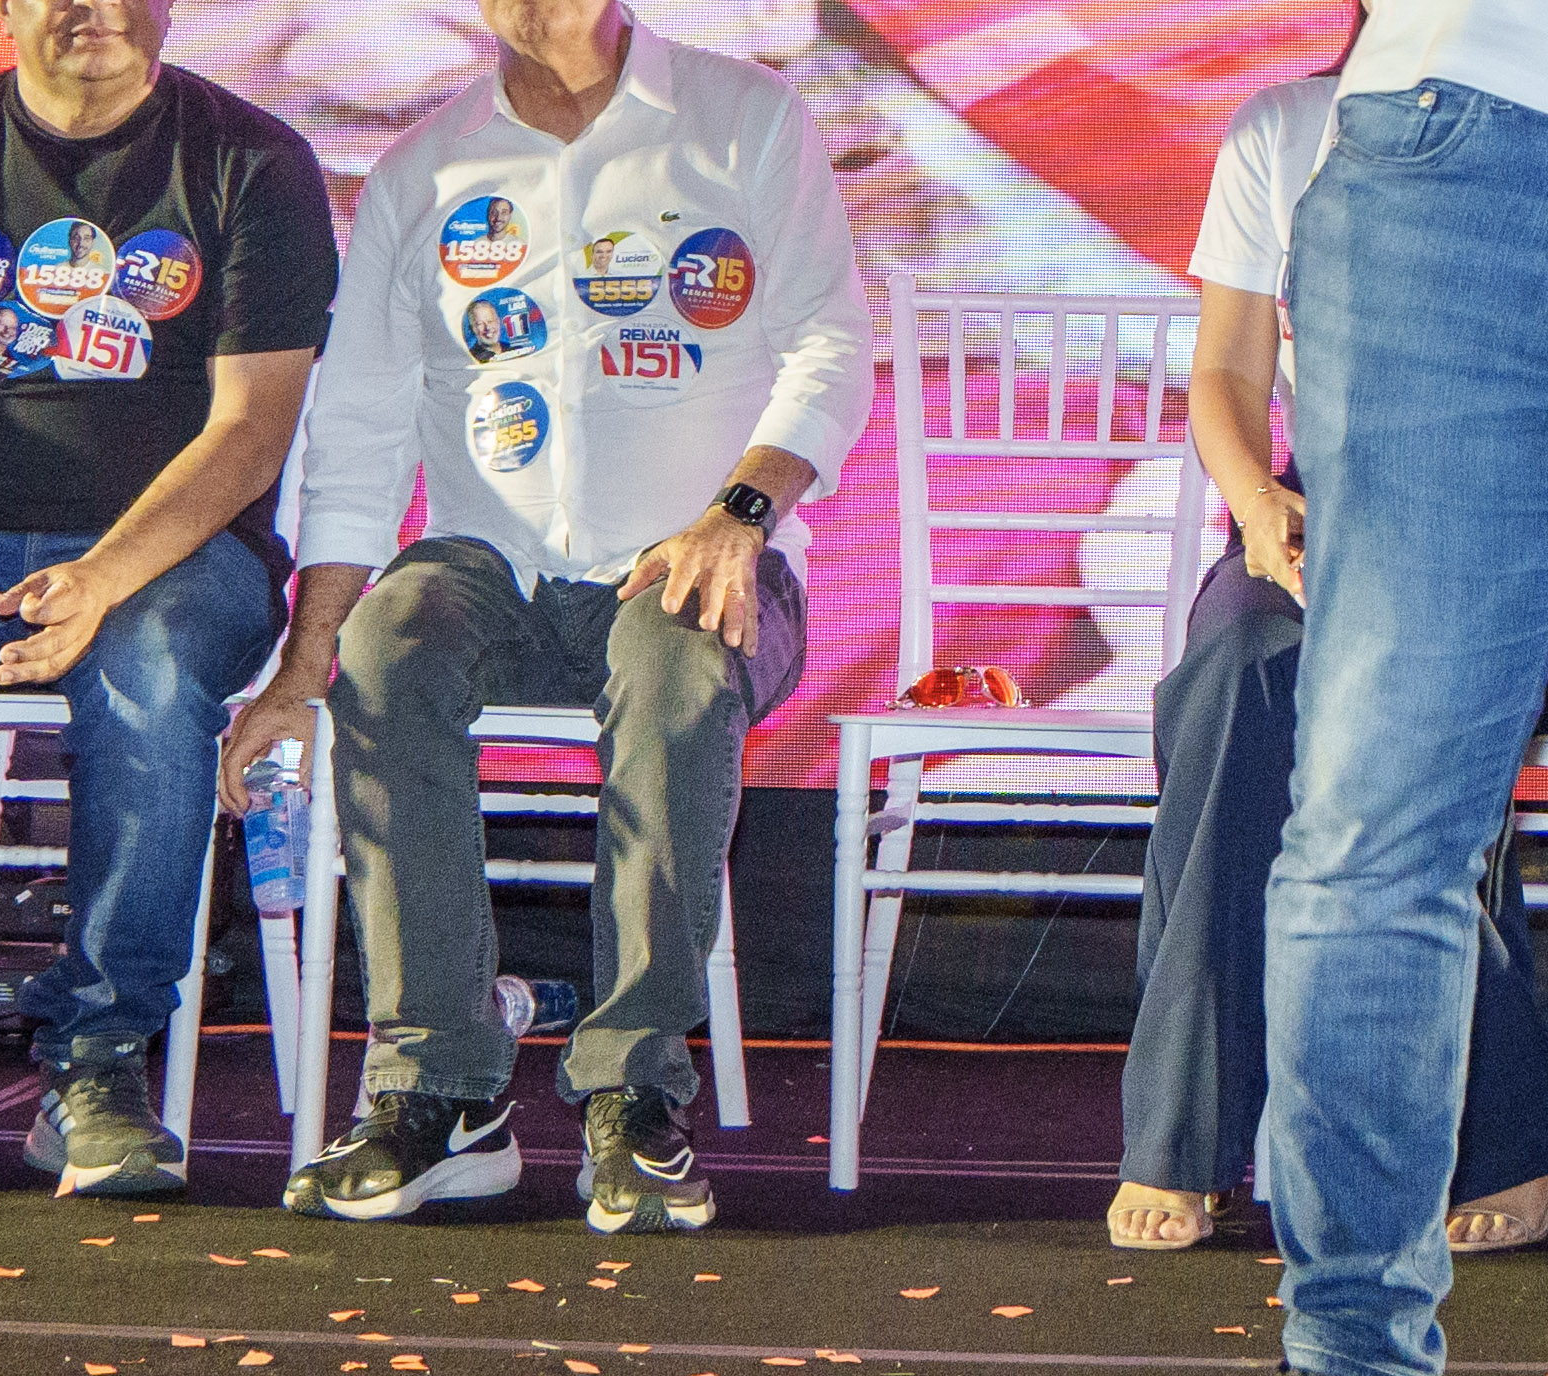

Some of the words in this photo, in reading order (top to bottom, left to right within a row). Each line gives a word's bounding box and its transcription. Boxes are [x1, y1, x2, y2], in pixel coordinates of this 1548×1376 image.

[444, 239, 524, 262] 15888
[23, 263, 104, 289] 15888
[156, 257, 191, 290] 15
[715, 256, 746, 292] 15
[588, 279, 654, 302] 5555
[82, 309, 142, 335] RENAN
[619, 328, 681, 342] RENAN
[76, 324, 138, 374] 151
[619, 341, 681, 380] 151
